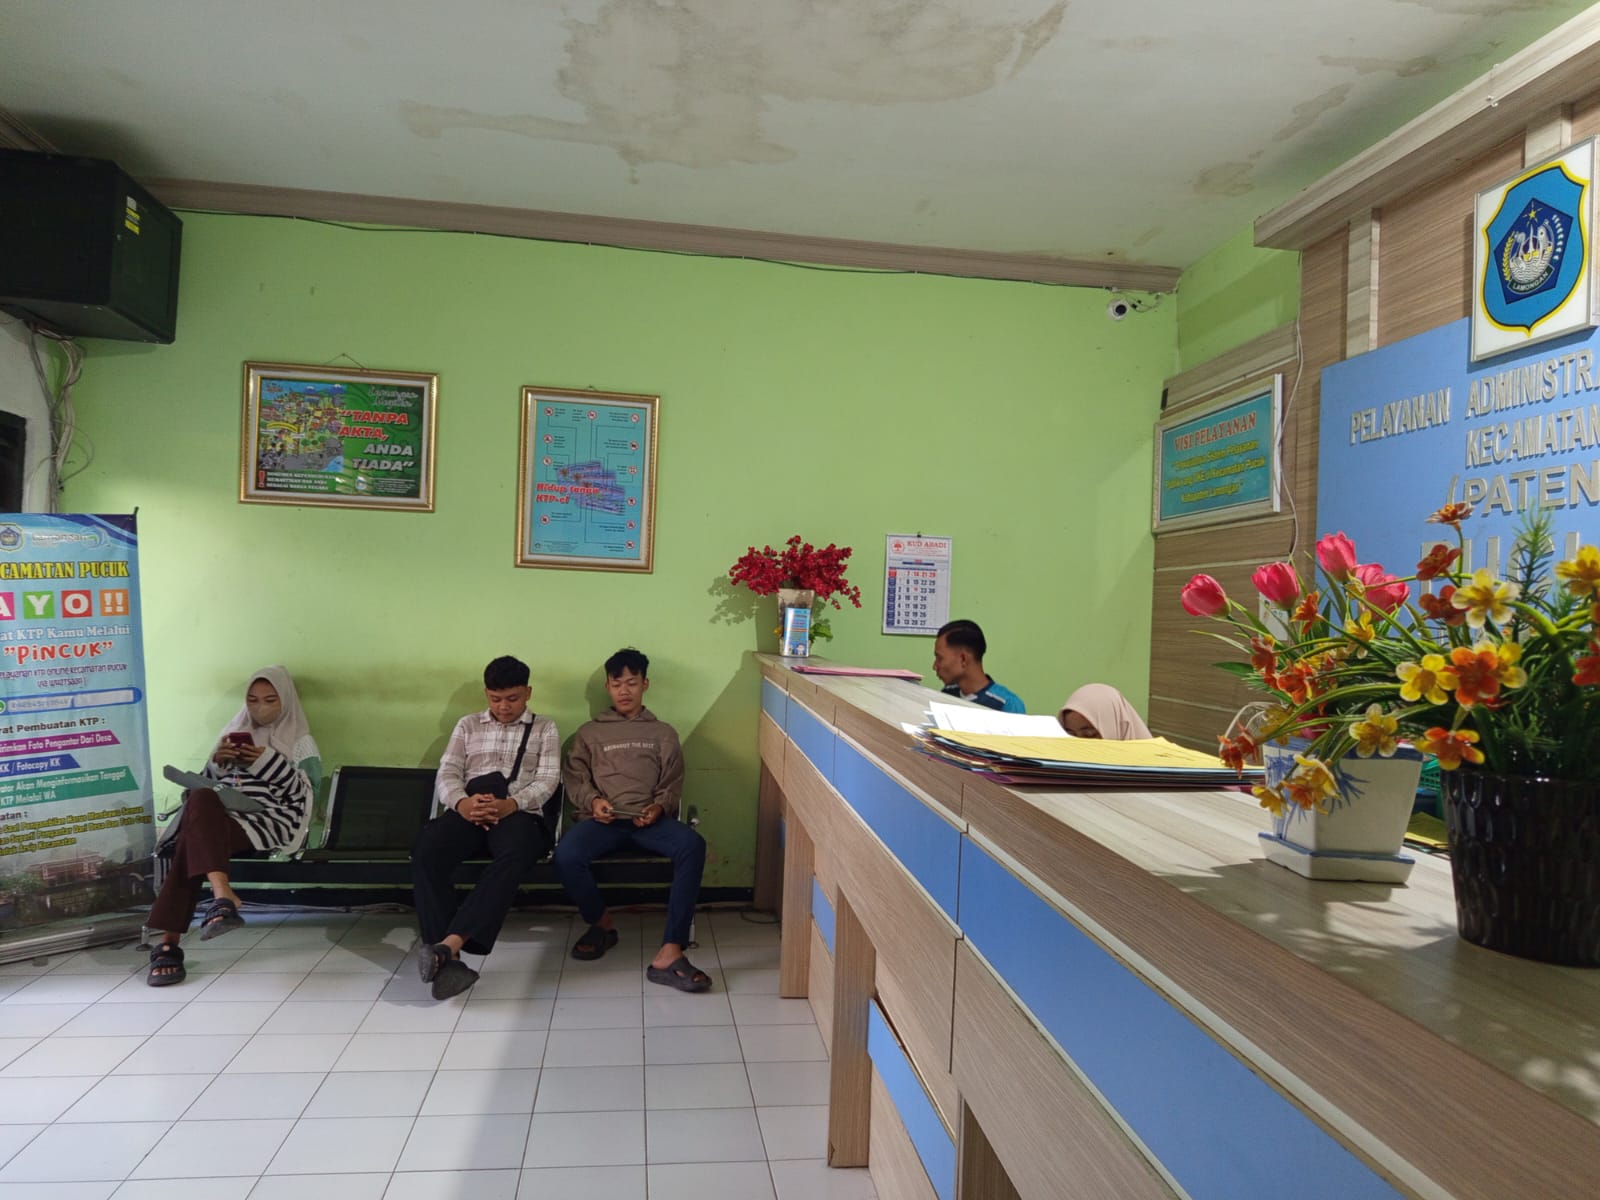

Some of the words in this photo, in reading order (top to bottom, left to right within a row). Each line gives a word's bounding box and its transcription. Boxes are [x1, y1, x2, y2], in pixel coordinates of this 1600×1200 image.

[1513, 271, 1549, 292] LAMONGAN
[1350, 387, 1451, 445] PELAYANAN
[1465, 349, 1600, 420] ADMINISTR
[338, 425, 388, 440] AKTA,
[1174, 433, 1193, 451] VISI
[1194, 412, 1257, 446] PELAYANAN
[363, 443, 413, 456] ANDA
[78, 561, 129, 578] PUCUK
[17, 628, 43, 640] KTP
[48, 627, 84, 639] Kamu
[86, 625, 130, 637] Melalui
[16, 719, 76, 732] Pembuatan
[79, 718, 100, 726] KTP
[80, 735, 94, 744] Dari
[16, 761, 48, 771] Fotocopy
